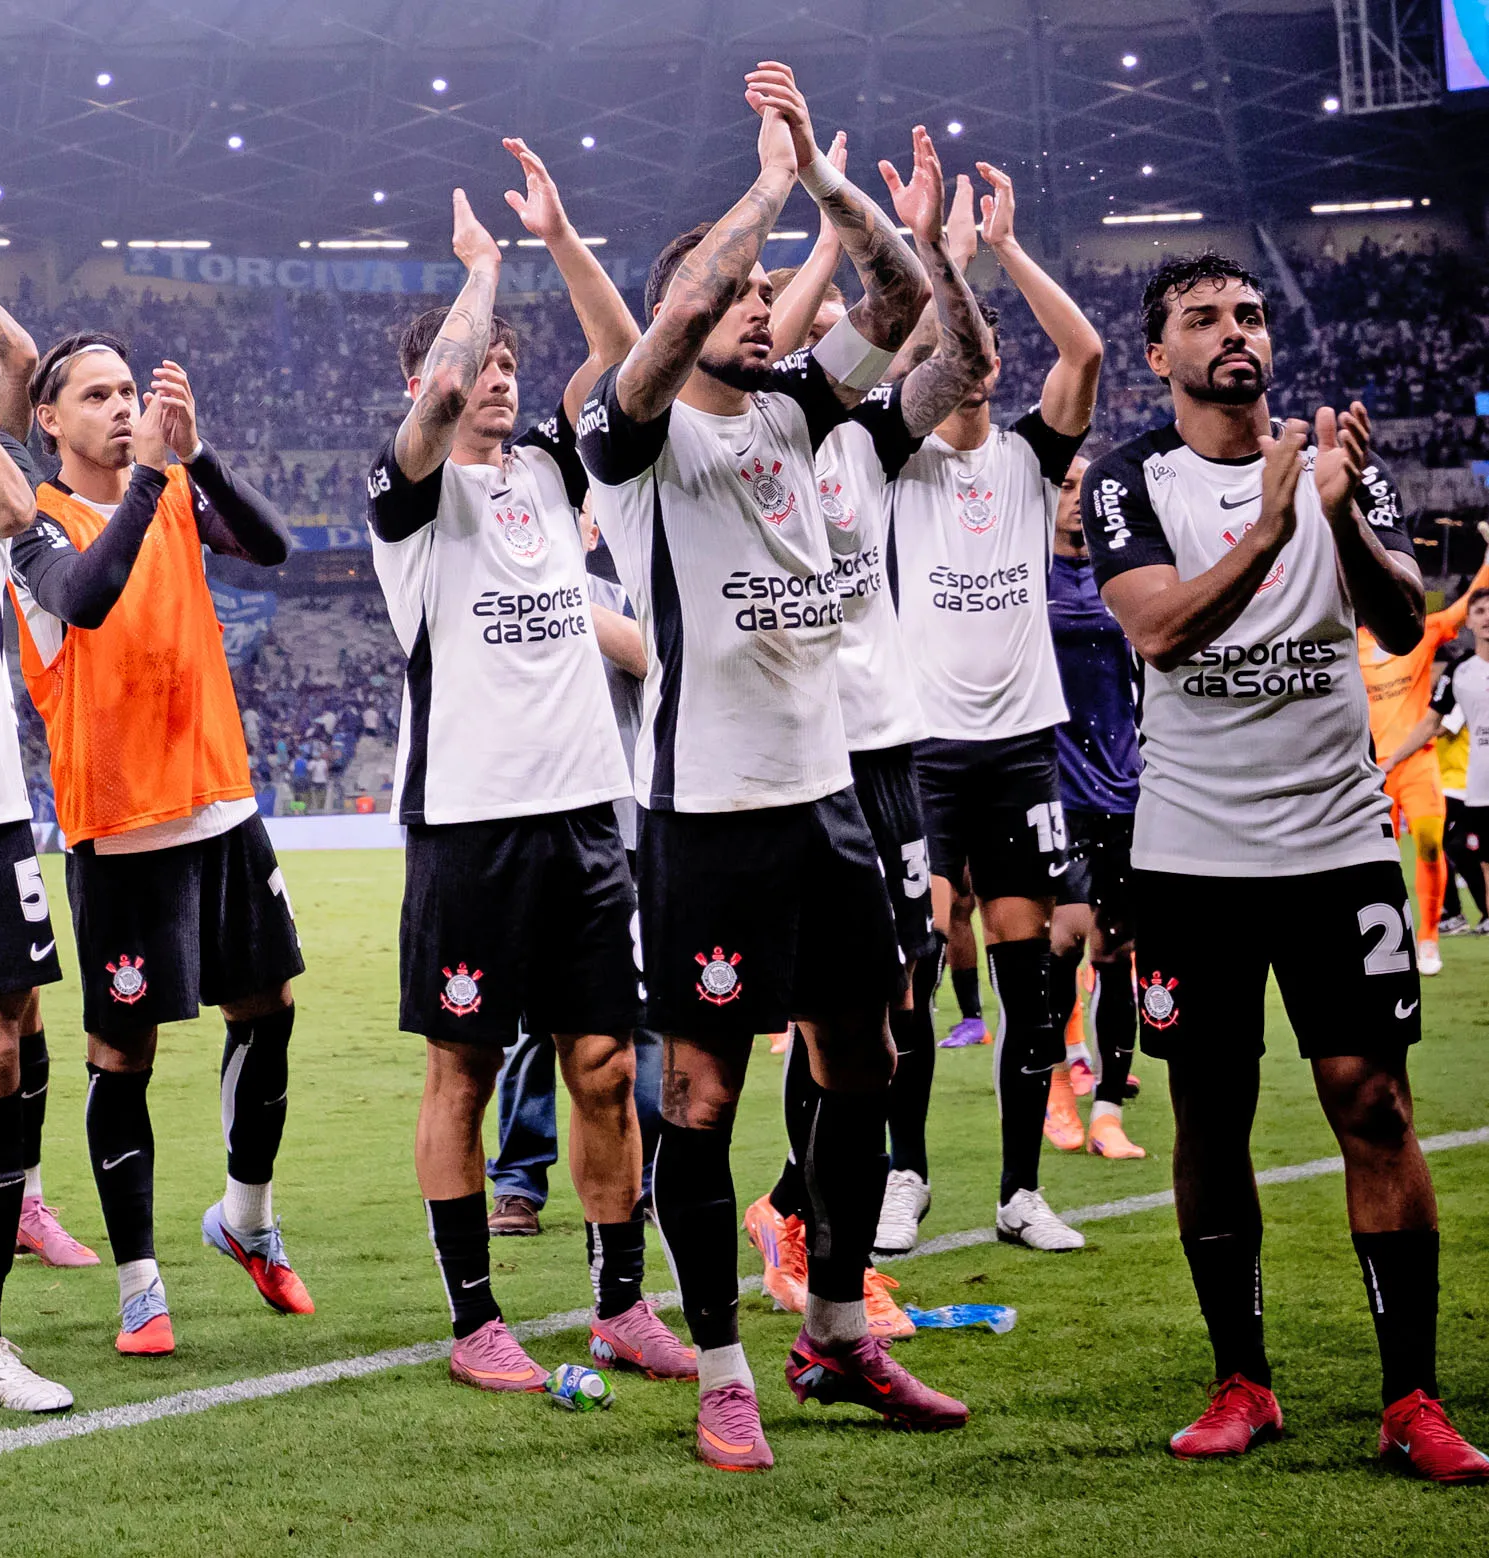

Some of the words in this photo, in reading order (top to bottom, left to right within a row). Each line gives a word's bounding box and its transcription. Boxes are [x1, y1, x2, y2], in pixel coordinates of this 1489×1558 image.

[722, 571, 837, 606] Esporte
[929, 563, 1029, 594] Esportes
[472, 586, 583, 621] Esportes
[1179, 637, 1337, 674] sportes
[14, 856, 49, 922] 5
